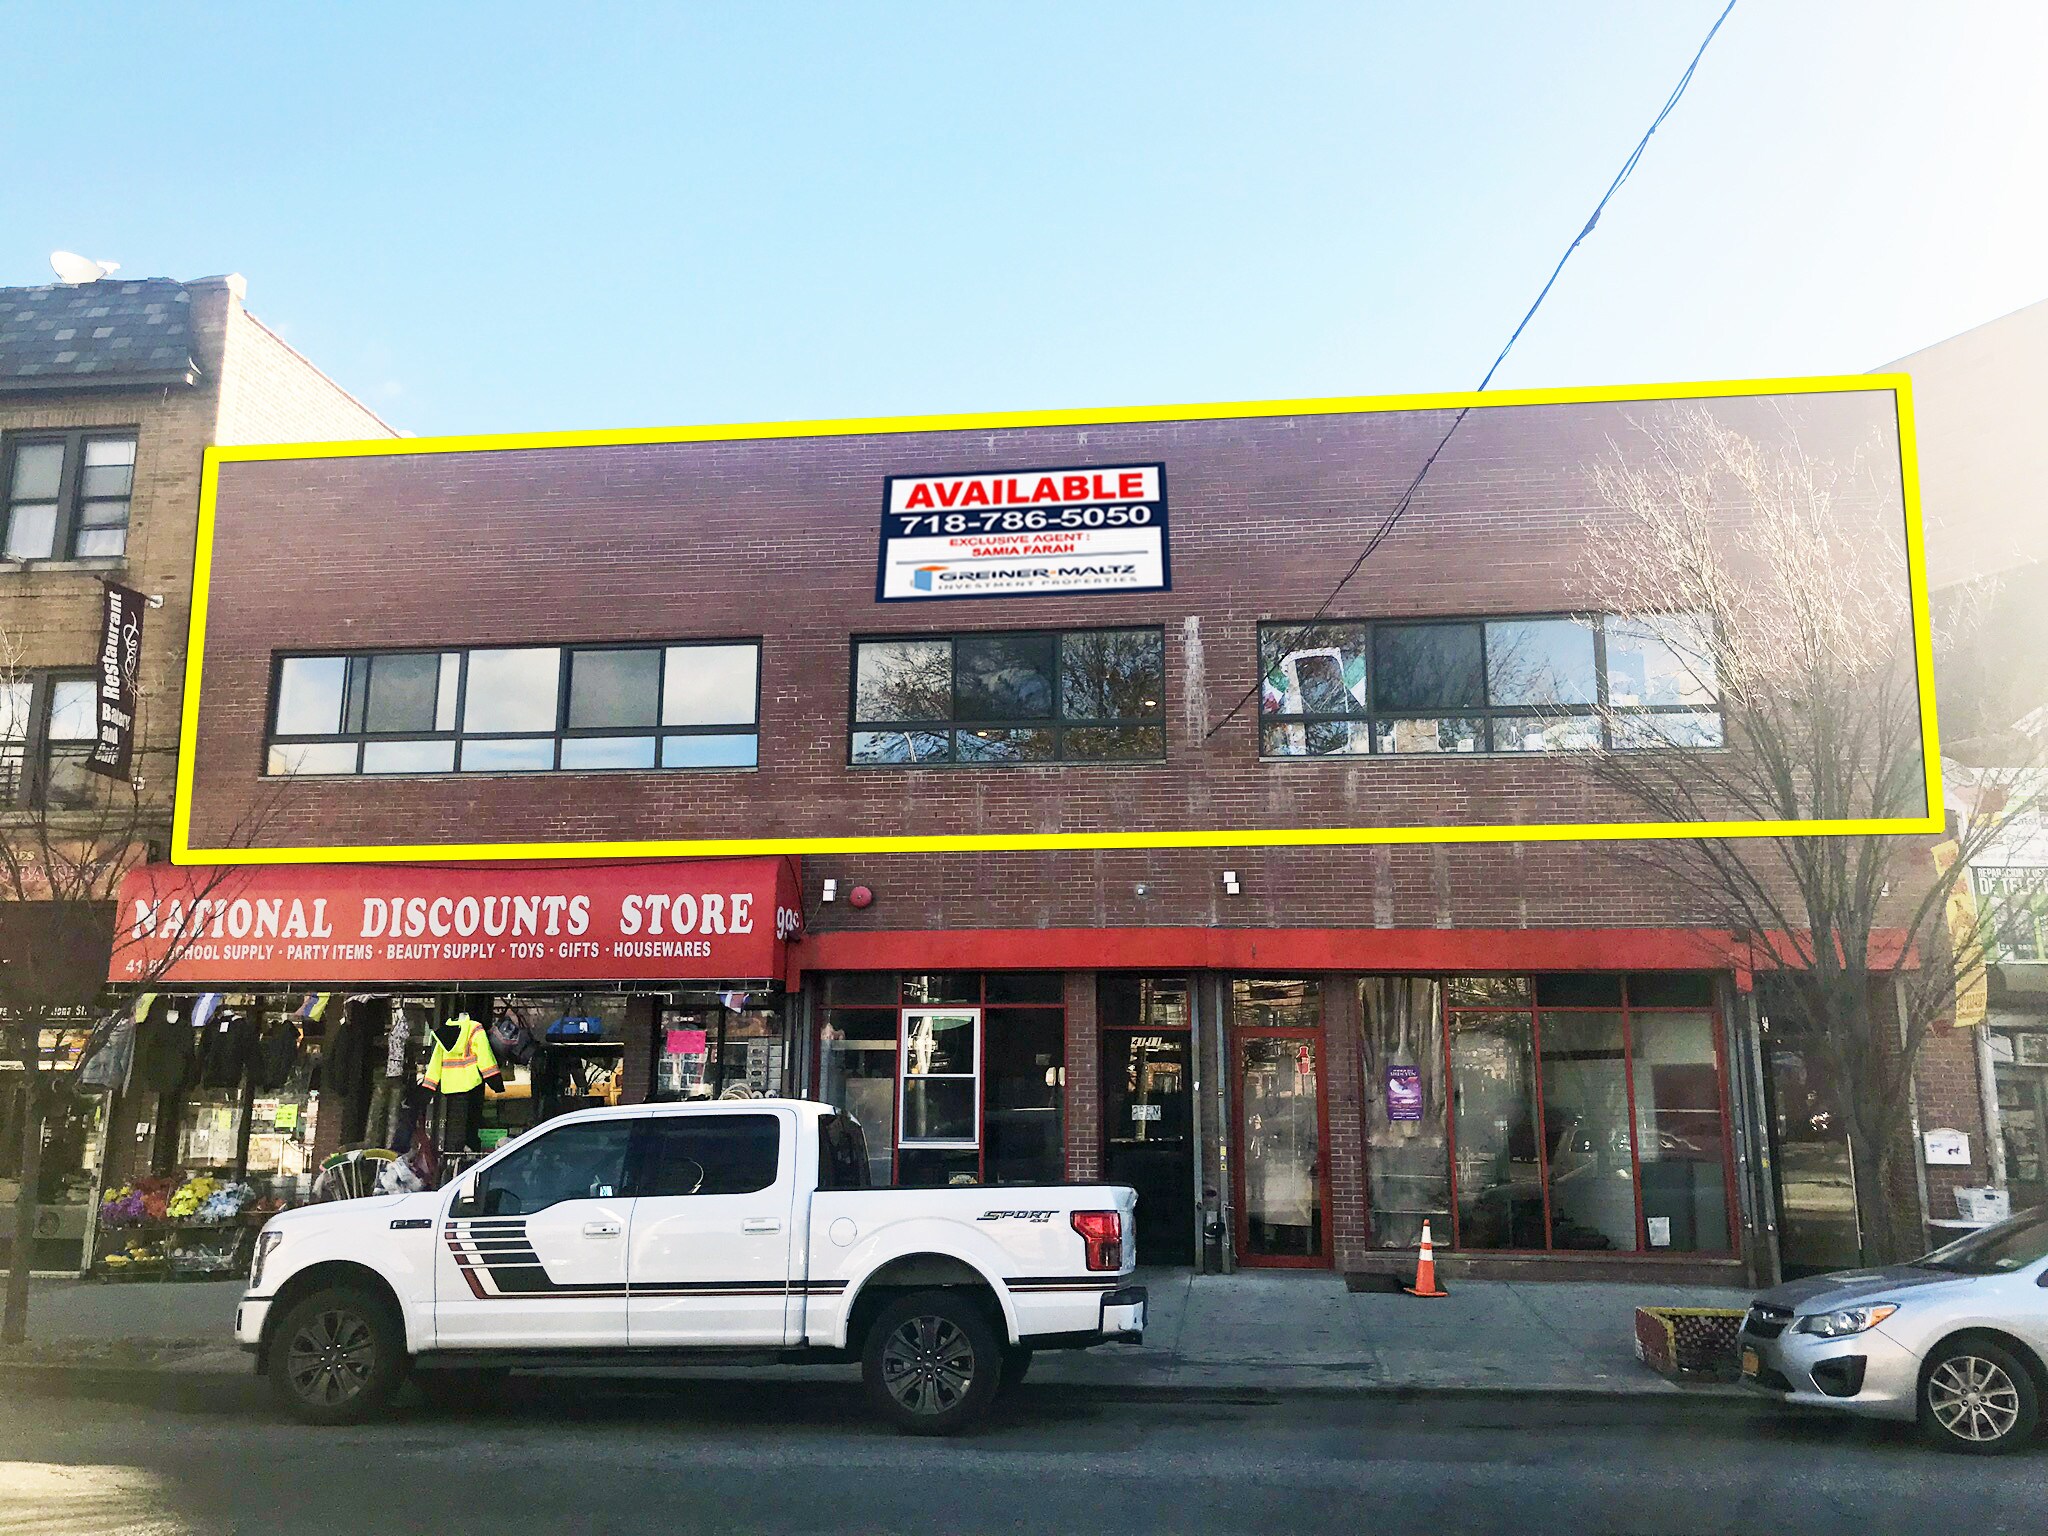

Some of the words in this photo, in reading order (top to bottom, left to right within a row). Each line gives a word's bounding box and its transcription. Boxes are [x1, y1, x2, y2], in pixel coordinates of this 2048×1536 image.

[905, 473, 1144, 509] AVAILABLE
[900, 505, 1152, 535] 718-786-5050
[949, 535, 1029, 547] EXCLUSIVE
[972, 546, 1020, 557] SAMIA
[1023, 544, 1075, 555] FARAH
[938, 580, 1034, 590] INVESTMENT
[1041, 577, 1138, 586] PROPERTIES
[102, 591, 122, 701] Restaurant
[131, 898, 333, 939] NATIONAL
[360, 894, 590, 938] DISCOUNTS
[620, 892, 753, 935] STORE
[168, 944, 219, 961] SCHOOL
[223, 944, 274, 960] SUPPLY
[286, 944, 330, 960] PARTY
[331, 944, 373, 960] ITEMS
[386, 943, 440, 960] BEAUTY
[443, 943, 496, 959] SUPPLY
[510, 942, 545, 959] TOYS
[558, 942, 600, 958] GIFTS
[613, 941, 711, 957] HOUSEWARES
[976, 1210, 1060, 1221] SPORT
